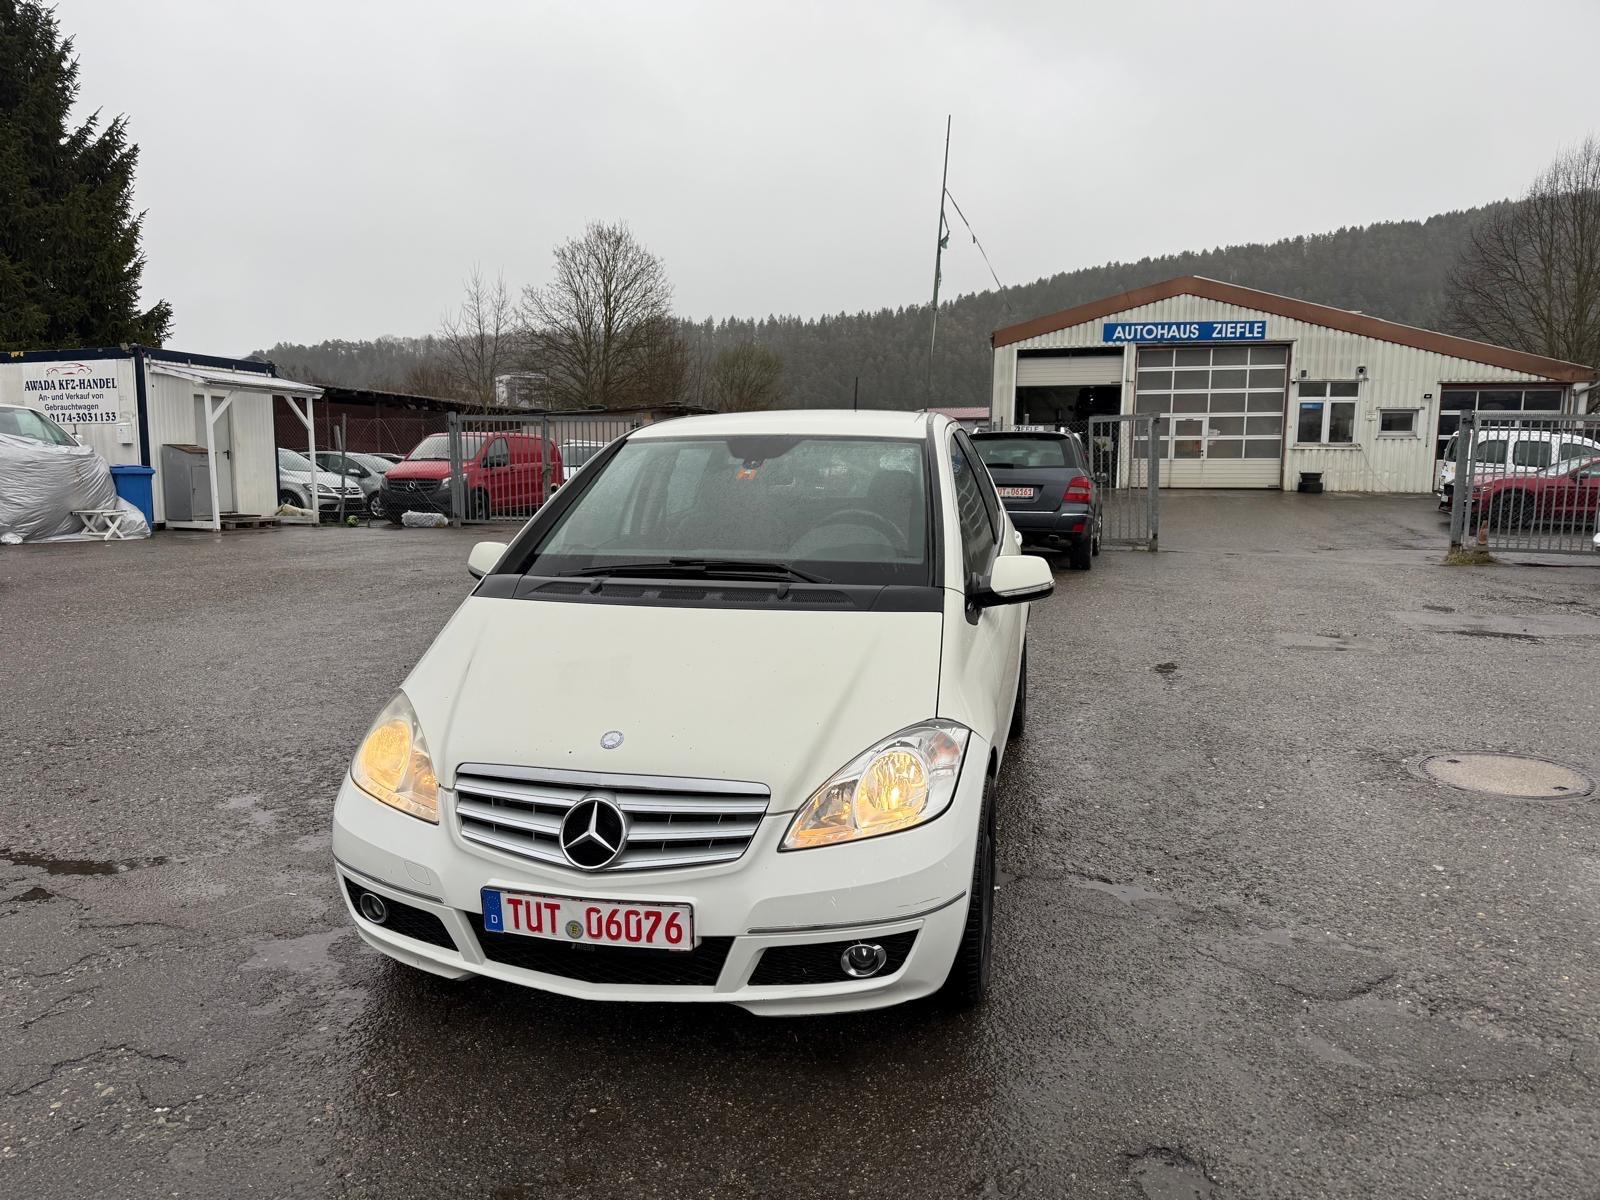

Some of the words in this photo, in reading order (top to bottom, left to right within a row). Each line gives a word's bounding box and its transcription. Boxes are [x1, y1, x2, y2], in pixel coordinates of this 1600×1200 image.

[1112, 324, 1199, 340] AUTOHAUS
[1211, 323, 1263, 338] ZIEFLE
[24, 380, 56, 391] AWADA
[58, 378, 117, 390] KFZ-HANDEL
[38, 393, 50, 402] An-
[65, 391, 90, 400] Verkauf
[44, 403, 99, 411] Gebrauchtwagen
[49, 411, 117, 423] 0174-3031133
[491, 914, 498, 924] D
[506, 897, 561, 936] TUT
[584, 906, 684, 945] 06076
